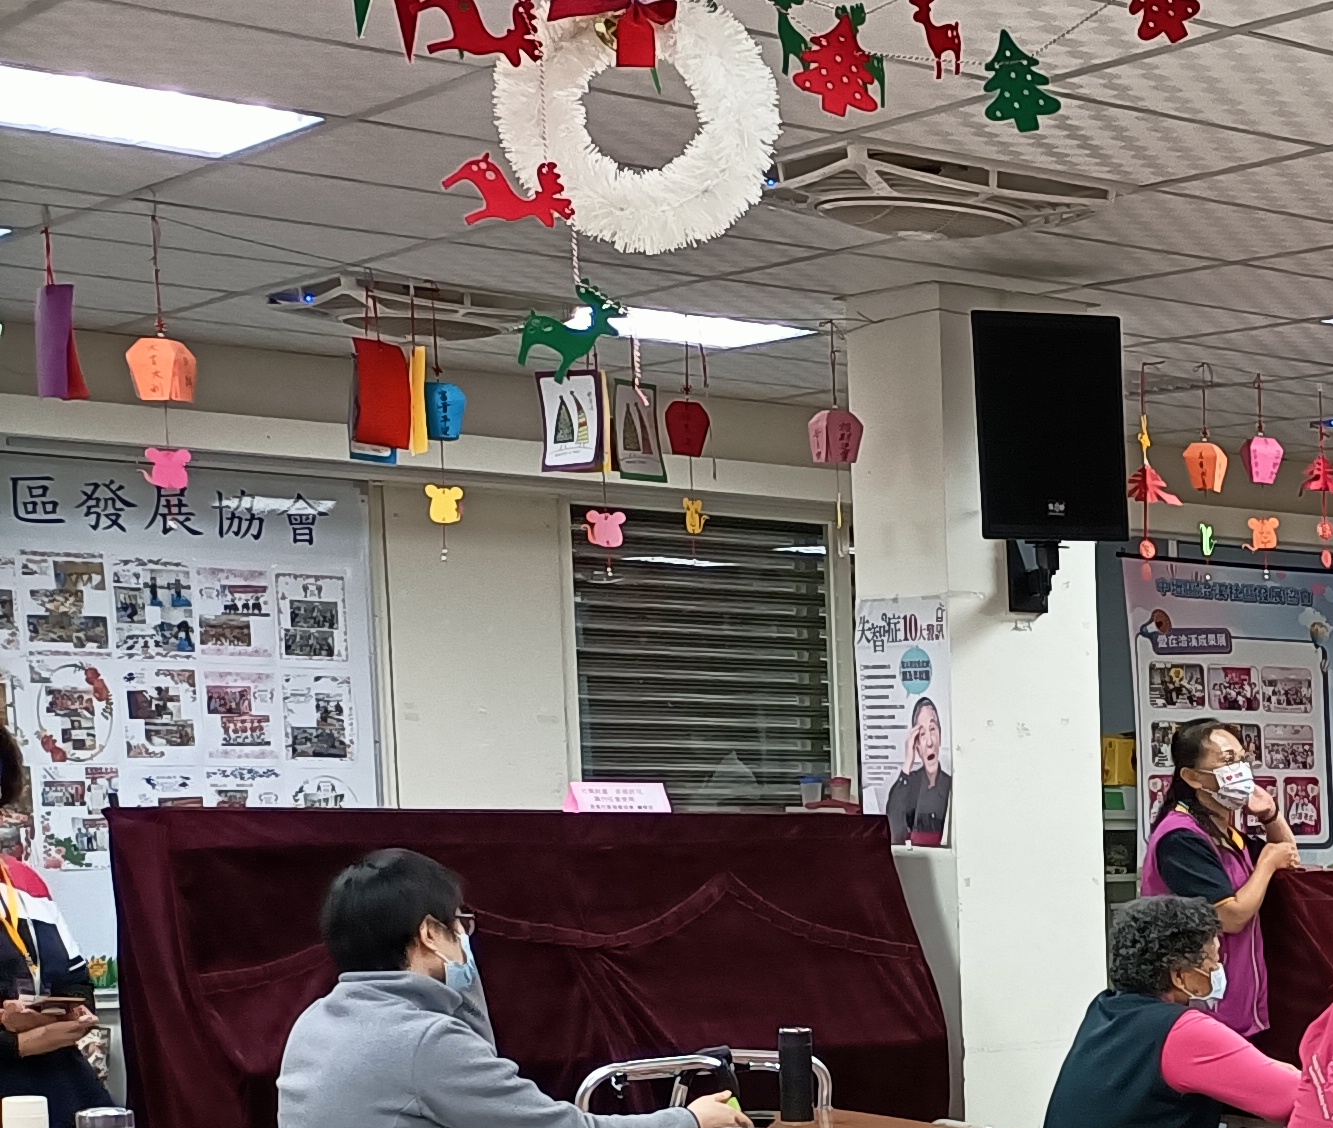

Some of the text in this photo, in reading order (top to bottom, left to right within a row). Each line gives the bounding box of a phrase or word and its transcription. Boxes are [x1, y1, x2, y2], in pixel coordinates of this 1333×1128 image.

[10, 475, 331, 546] 區發展協會
